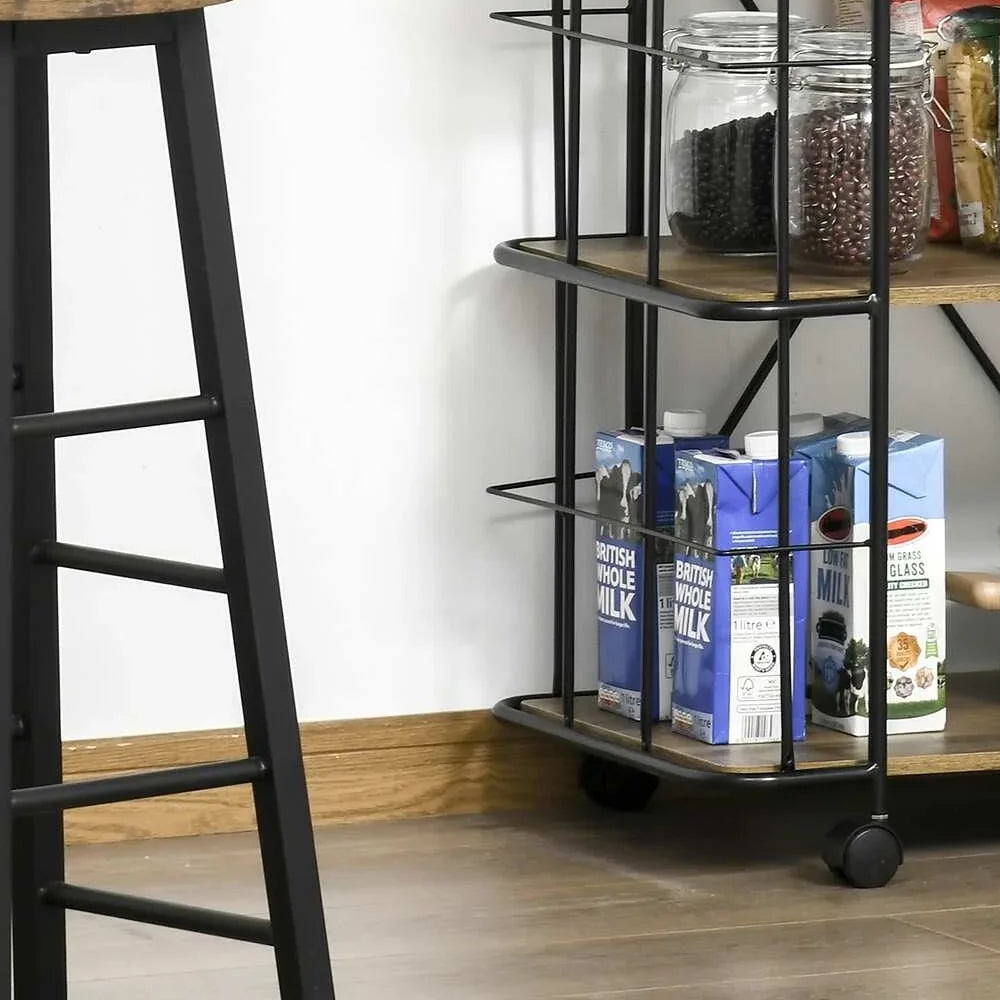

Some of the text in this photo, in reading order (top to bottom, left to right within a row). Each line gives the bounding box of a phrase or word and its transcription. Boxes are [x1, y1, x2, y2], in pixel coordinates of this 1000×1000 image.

[889, 562, 925, 578] GLASS
[897, 551, 922, 561] GRASS
[676, 560, 714, 588] BRITISH
[817, 567, 850, 609] MILK
[675, 582, 712, 611] WHOLE
[674, 604, 711, 642] MILK
[740, 619, 763, 631] litre
